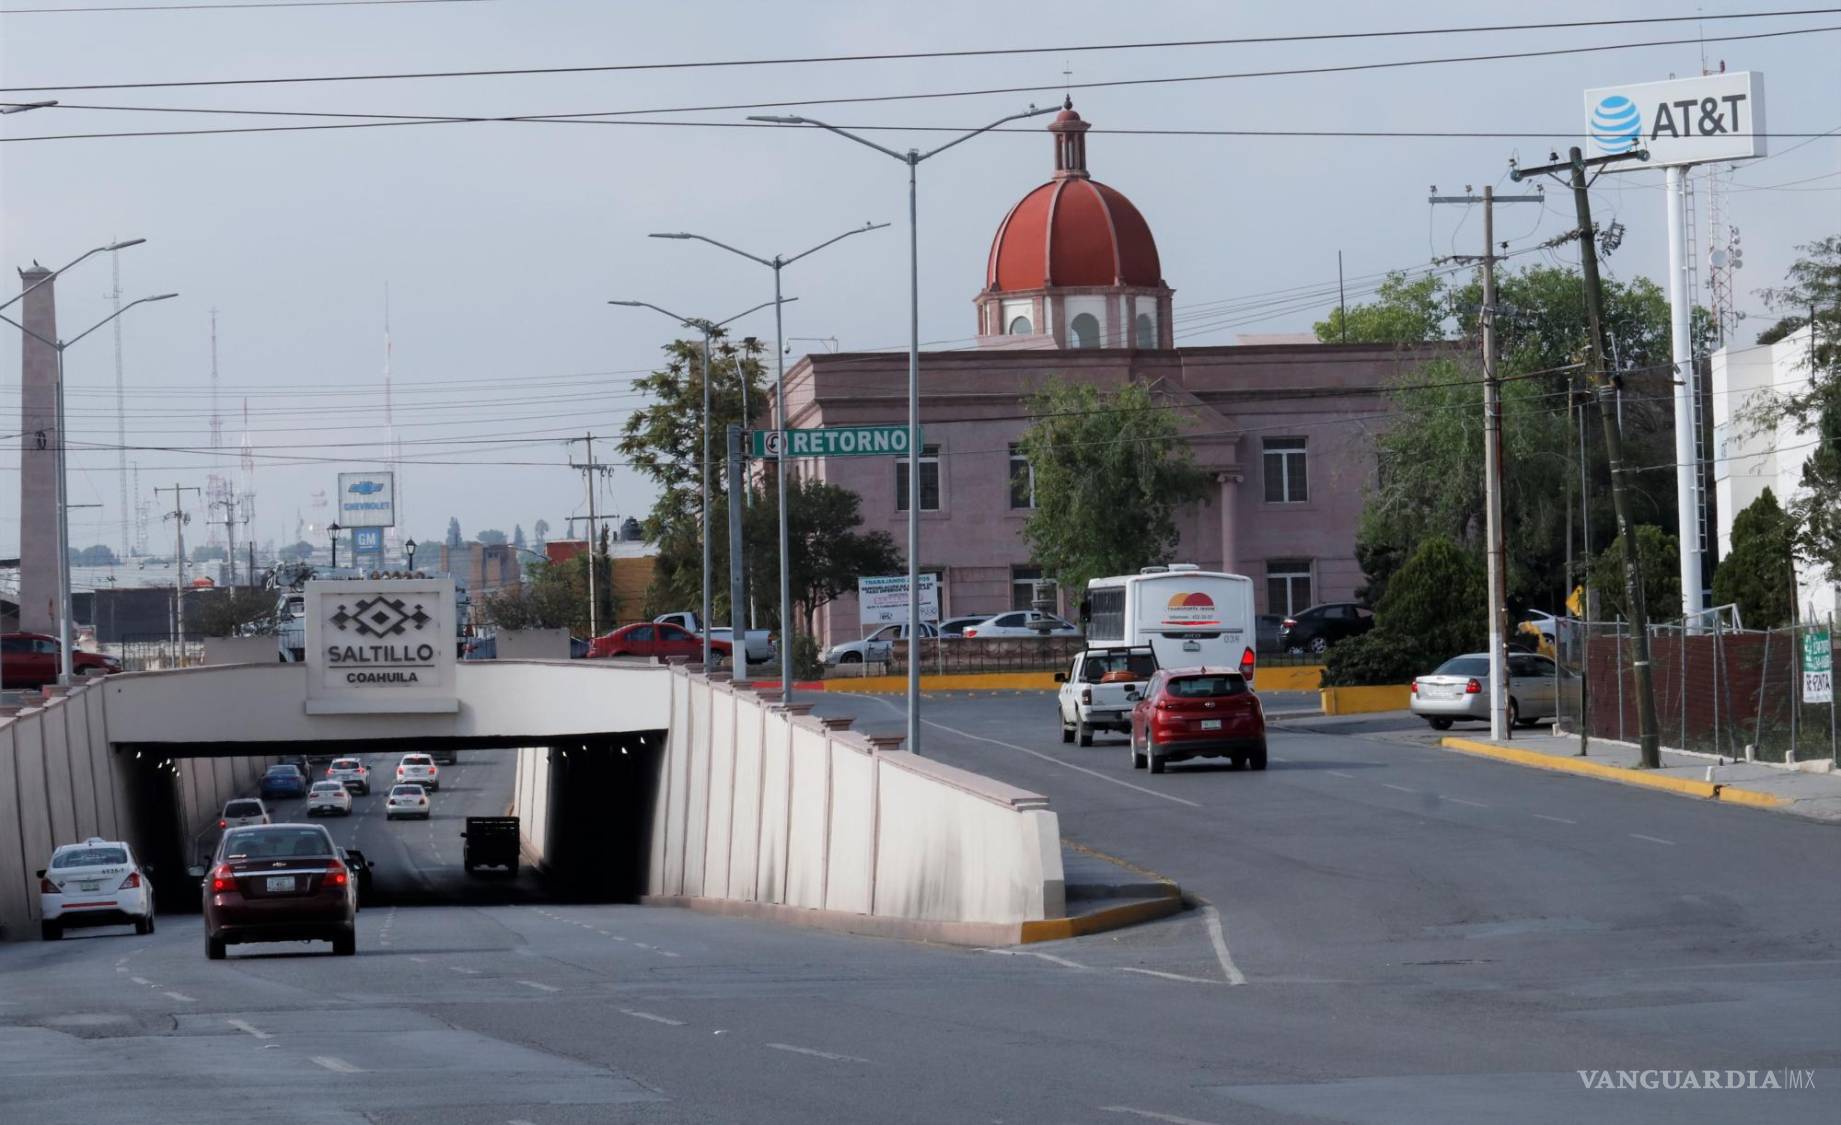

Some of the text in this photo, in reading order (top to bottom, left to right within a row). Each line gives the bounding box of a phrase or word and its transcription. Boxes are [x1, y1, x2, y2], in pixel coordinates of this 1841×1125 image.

[1651, 94, 1746, 141] AT&T
[793, 429, 907, 453] RETORNO
[343, 502, 390, 511] CHEVROLET
[358, 532, 376, 545] GM
[328, 644, 434, 662] SALTILLO
[346, 672, 418, 683] COAHUILA
